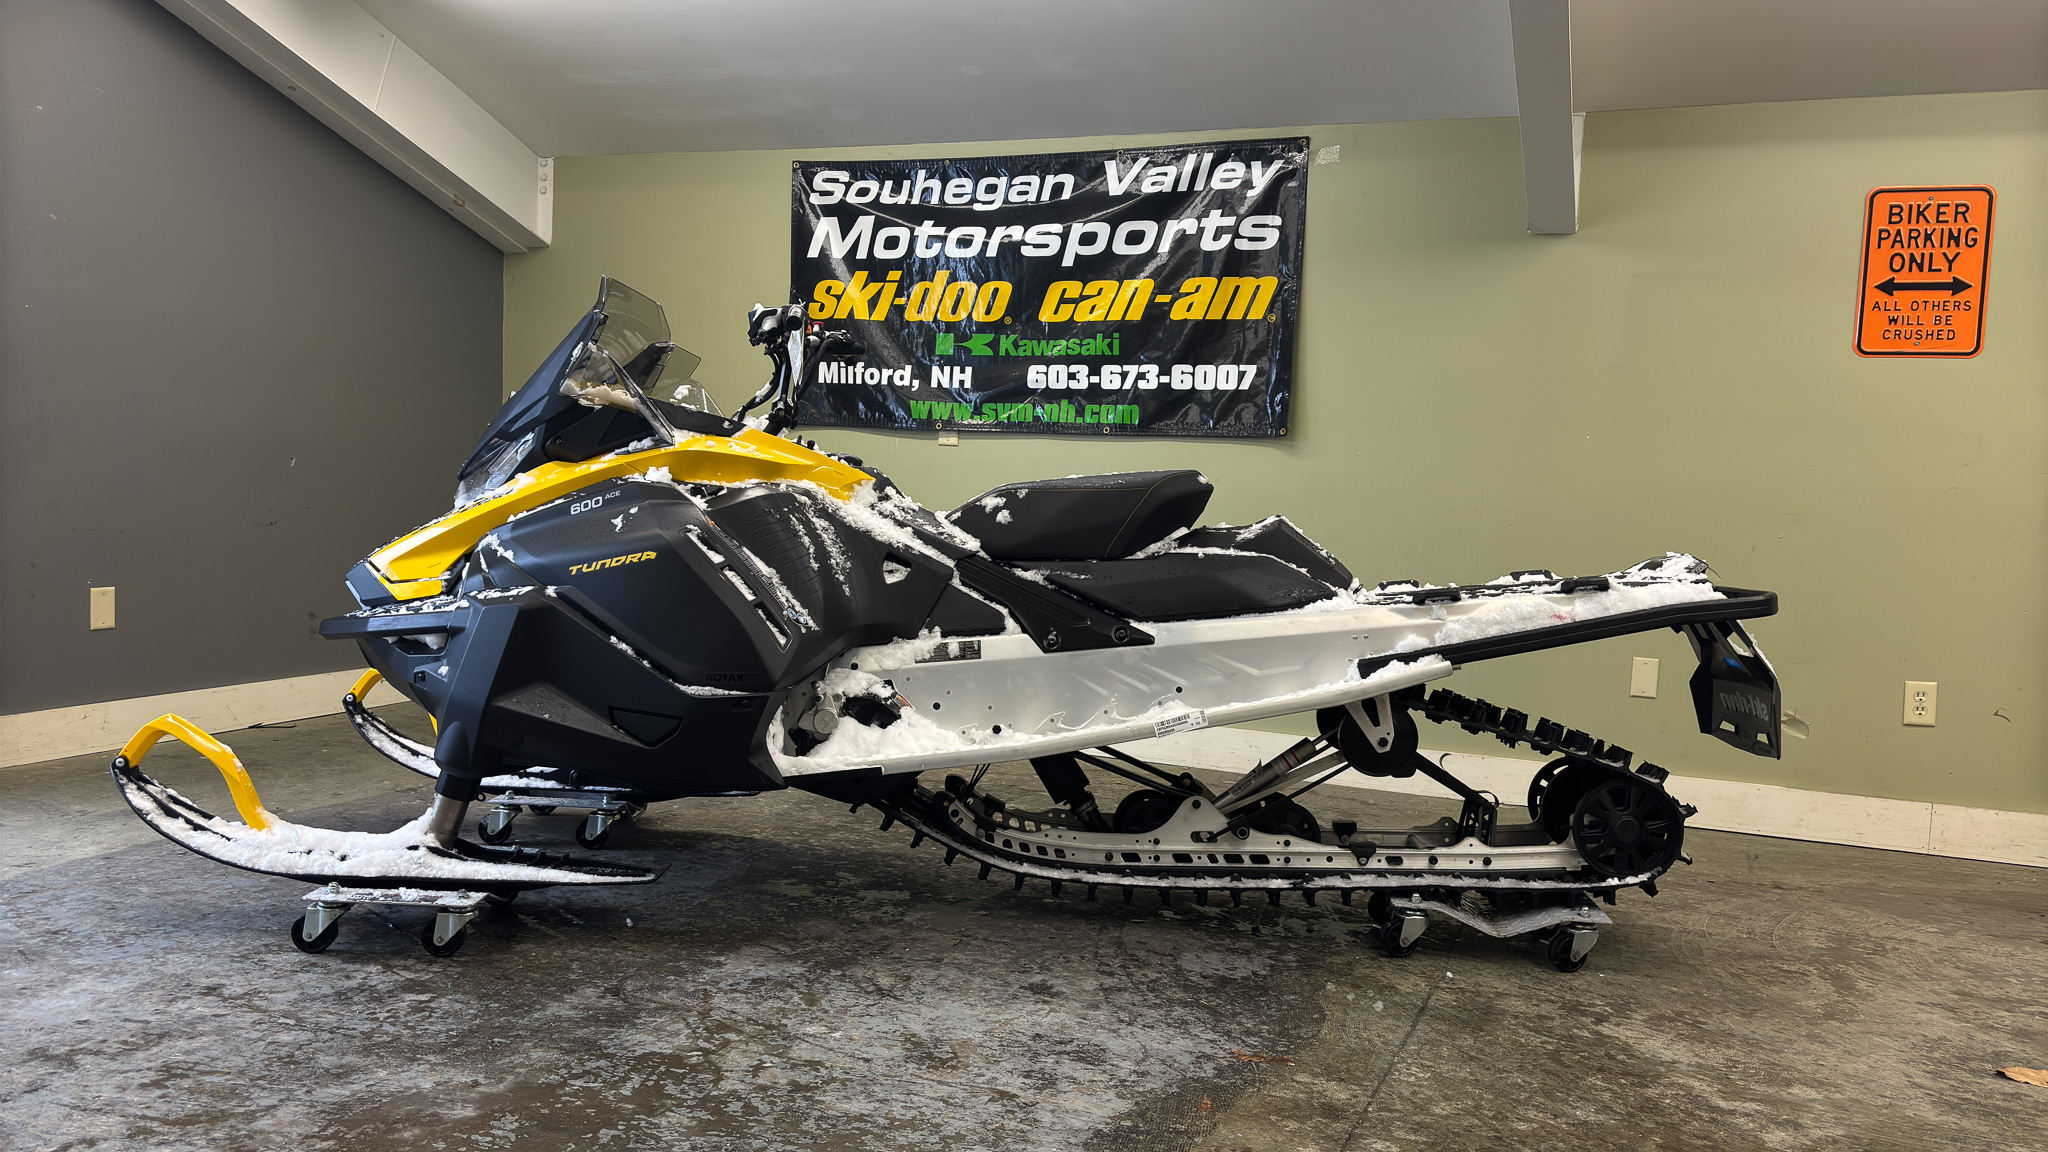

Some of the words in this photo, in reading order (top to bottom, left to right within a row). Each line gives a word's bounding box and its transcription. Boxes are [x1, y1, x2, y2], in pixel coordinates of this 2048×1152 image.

[808, 168, 1075, 212] Souhegan
[1103, 153, 1285, 197] Valley
[1887, 202, 1971, 225] BIKER
[806, 209, 1283, 267] Motorsports
[1877, 227, 1979, 249] PARKING
[1889, 251, 1962, 273] ONLY
[1872, 300, 1902, 311] ALL
[1911, 300, 1972, 311] OTHERS
[1888, 315, 1924, 326] WILL
[1933, 315, 1953, 326] BE
[999, 333, 1120, 357] Kawasaki
[1882, 329, 1956, 341] CRUSHED
[817, 361, 920, 391] Milford,
[930, 365, 973, 389] NH
[1026, 364, 1257, 391] 603-673-6007
[910, 399, 1139, 424] www.svm-nh.com
[570, 496, 603, 515] 600
[604, 490, 621, 500] ACE
[568, 551, 658, 576] TUNDRA
